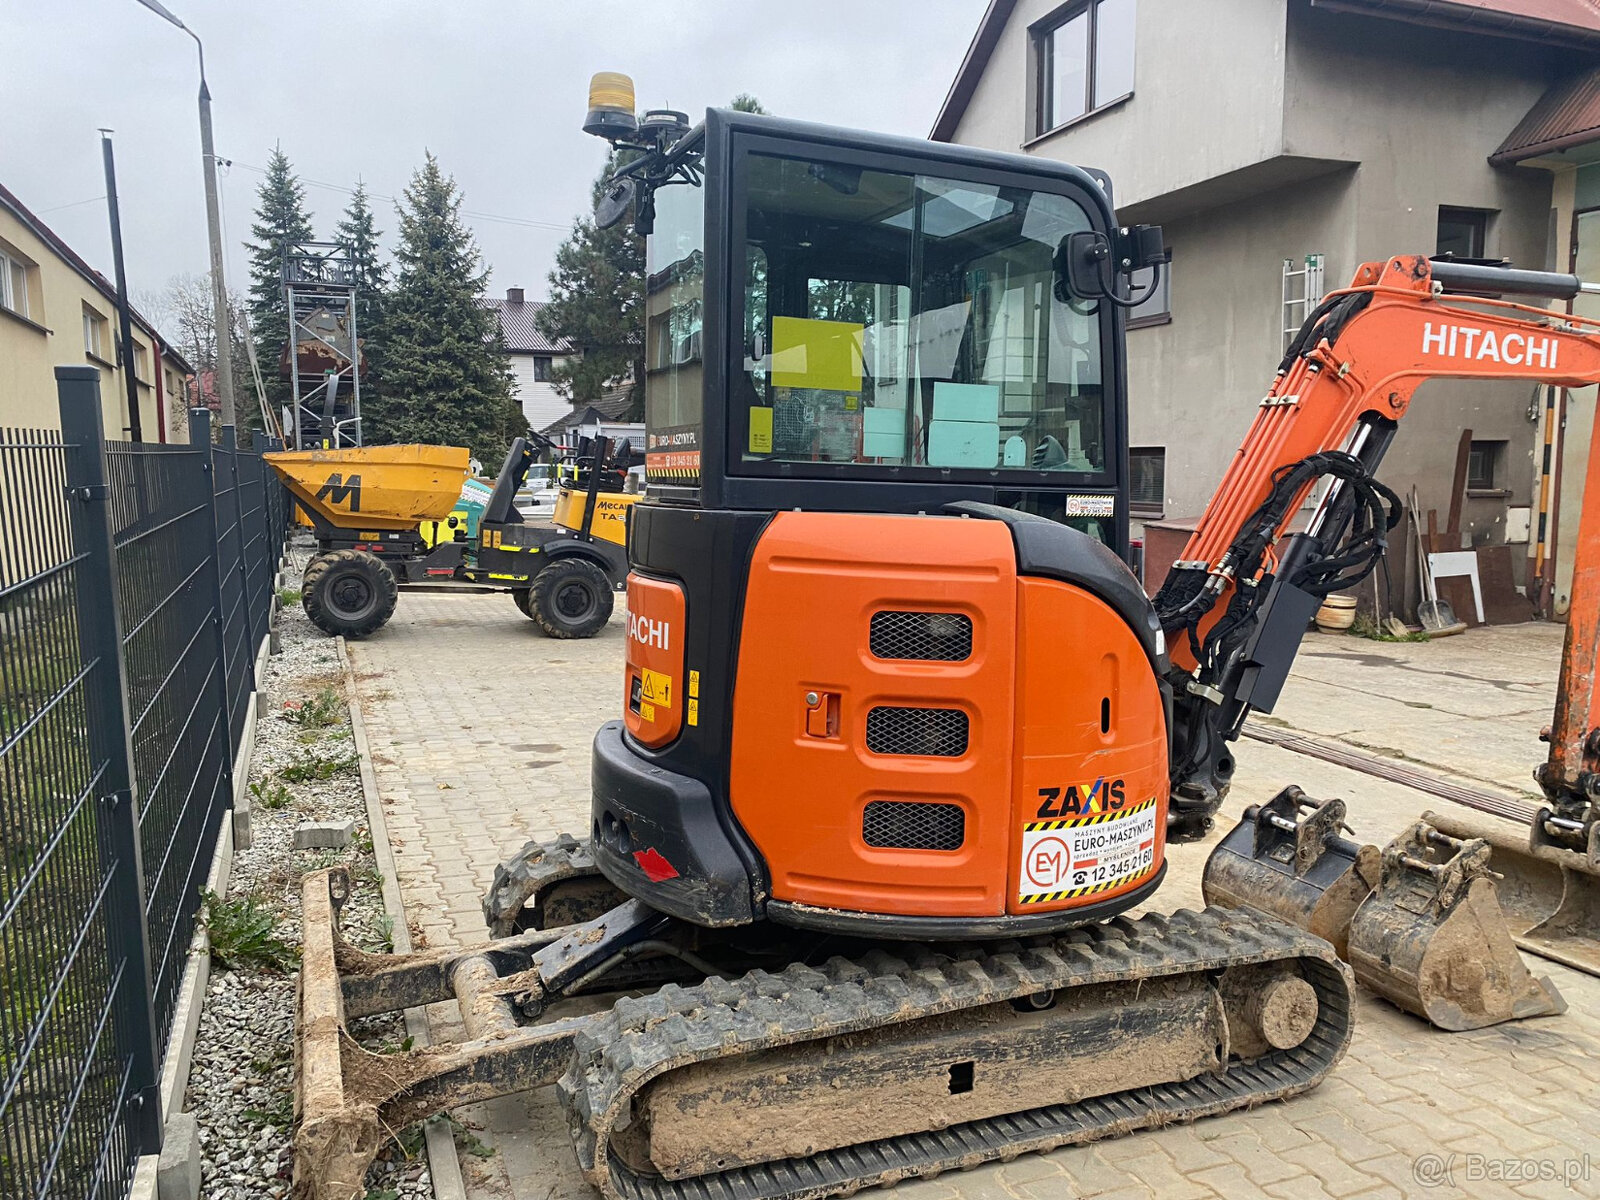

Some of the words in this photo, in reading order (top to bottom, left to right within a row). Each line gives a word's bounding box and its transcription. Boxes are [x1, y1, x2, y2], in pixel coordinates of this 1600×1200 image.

[1422, 322, 1558, 369] HITACHI
[625, 610, 669, 650] TACHI
[1037, 776, 1125, 818] ZAXIS
[1074, 819, 1153, 852] EURO-MASZYNY.PL
[1075, 827, 1105, 837] MASZYNY
[1107, 817, 1138, 832] BUDOWLANE
[1092, 867, 1105, 881] 12
[1109, 859, 1130, 877] 345
[1132, 852, 1141, 870] 21
[1143, 848, 1152, 864] 60
[1103, 848, 1136, 862] MYŚLENICE
